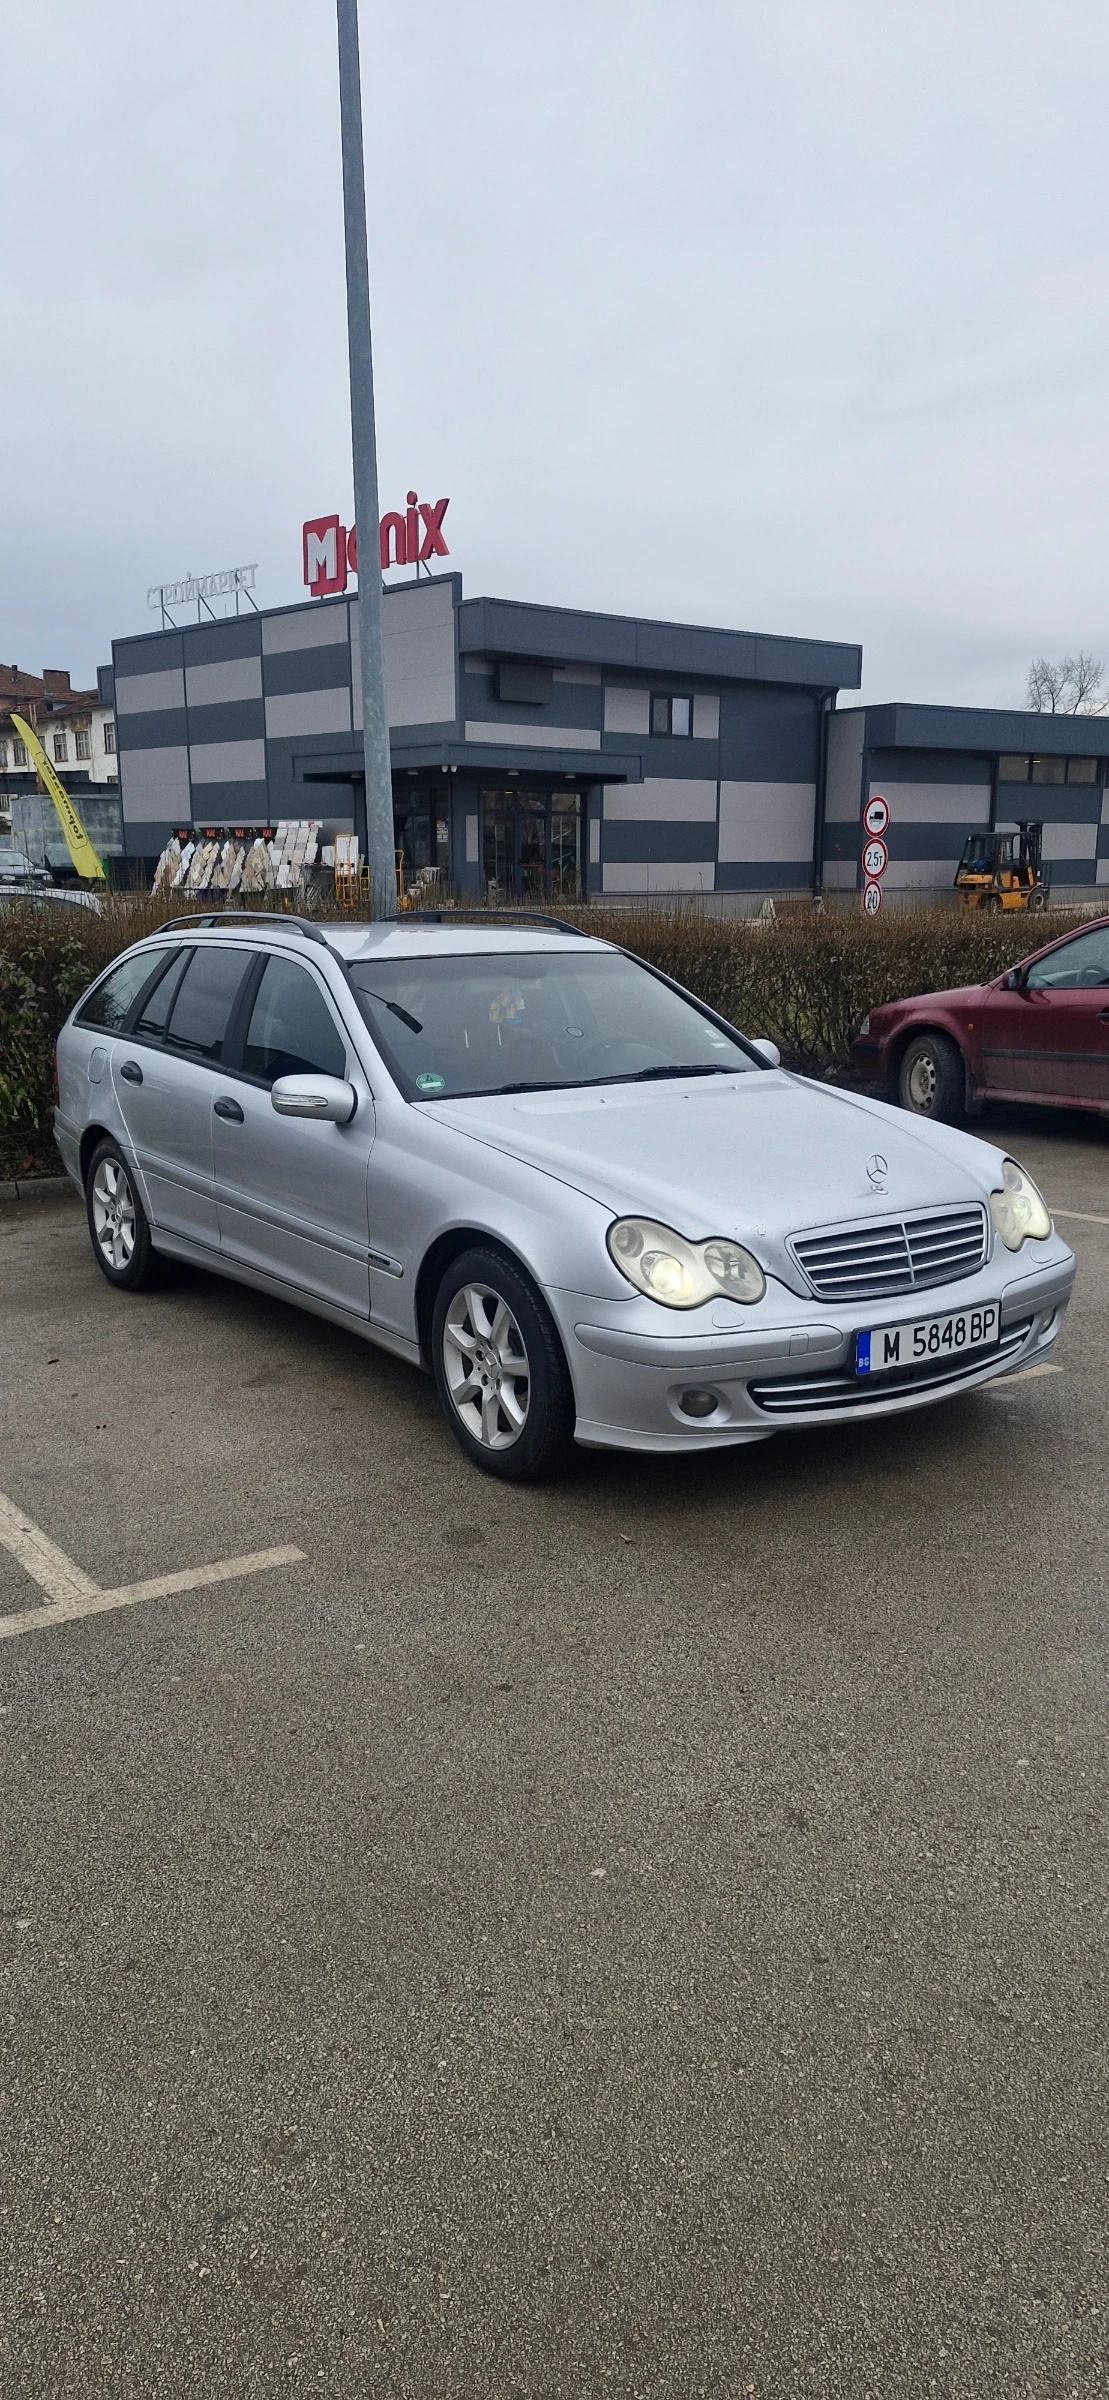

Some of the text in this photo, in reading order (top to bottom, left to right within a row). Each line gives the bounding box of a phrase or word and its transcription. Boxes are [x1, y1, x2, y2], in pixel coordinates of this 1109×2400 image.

[306, 491, 450, 584] Mnix
[146, 563, 258, 610] СТРОЙМАРКЕТ
[867, 890, 878, 909] 20
[858, 1357, 870, 1368] BG
[883, 1331, 900, 1364] M
[913, 1317, 966, 1357] 5848
